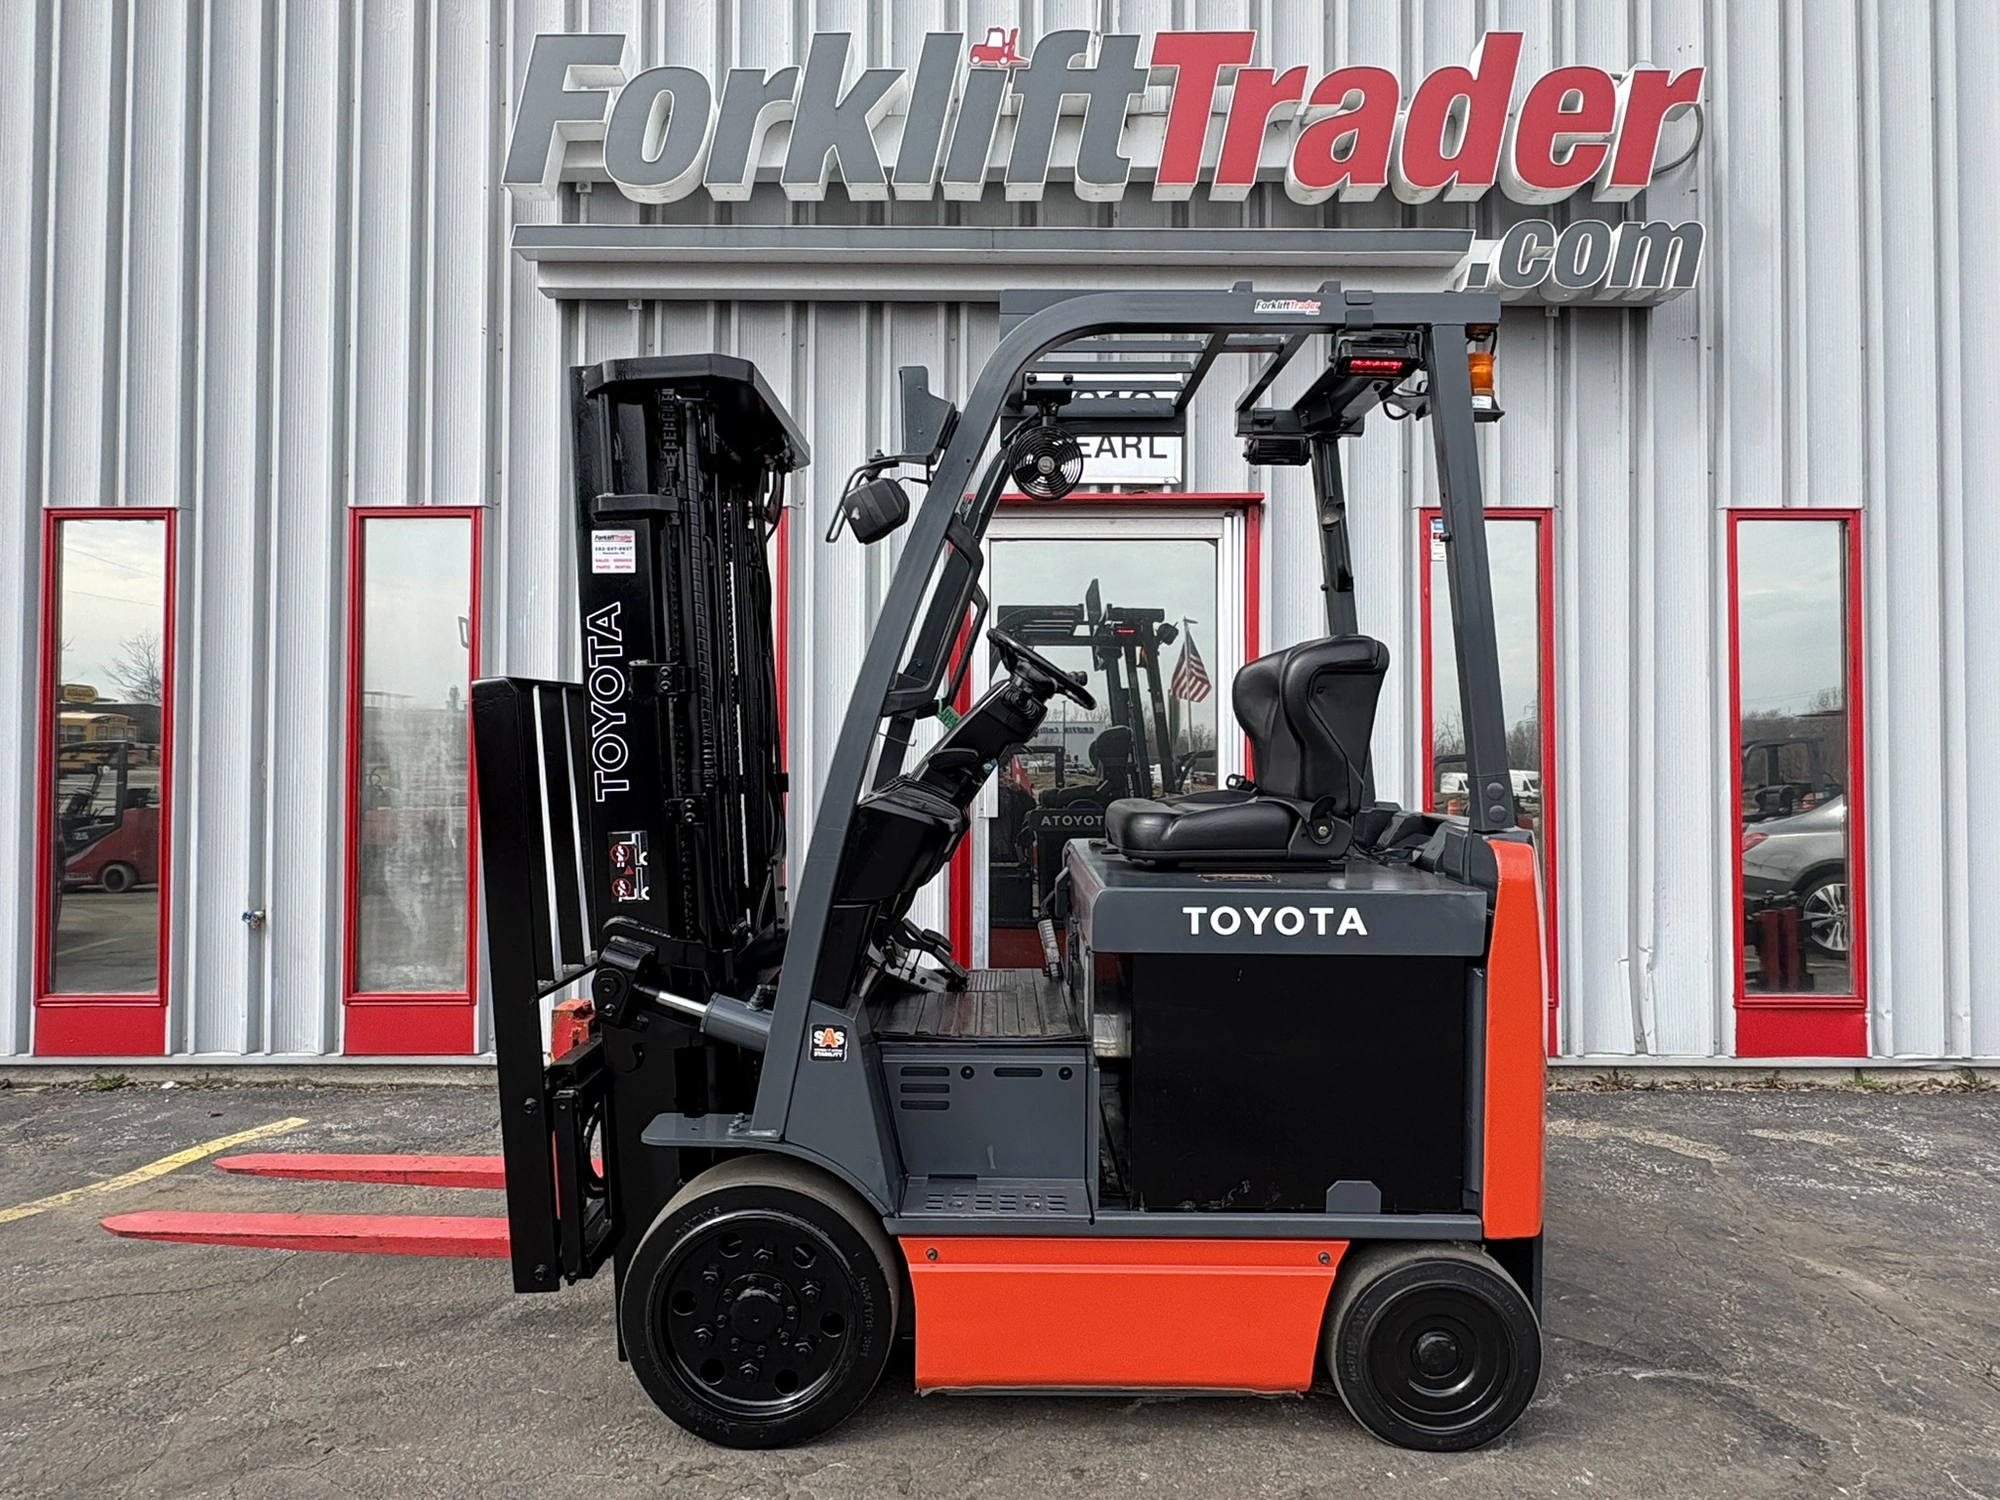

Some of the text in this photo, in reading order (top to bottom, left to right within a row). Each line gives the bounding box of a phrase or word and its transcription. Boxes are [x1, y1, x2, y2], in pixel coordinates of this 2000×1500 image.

[503, 30, 1707, 200] ForkliftTrader
[1466, 218, 1706, 291] .com
[587, 601, 630, 803] TOYOTA
[1182, 905, 1368, 936] TOYOTA
[813, 1027, 845, 1048] SAS
